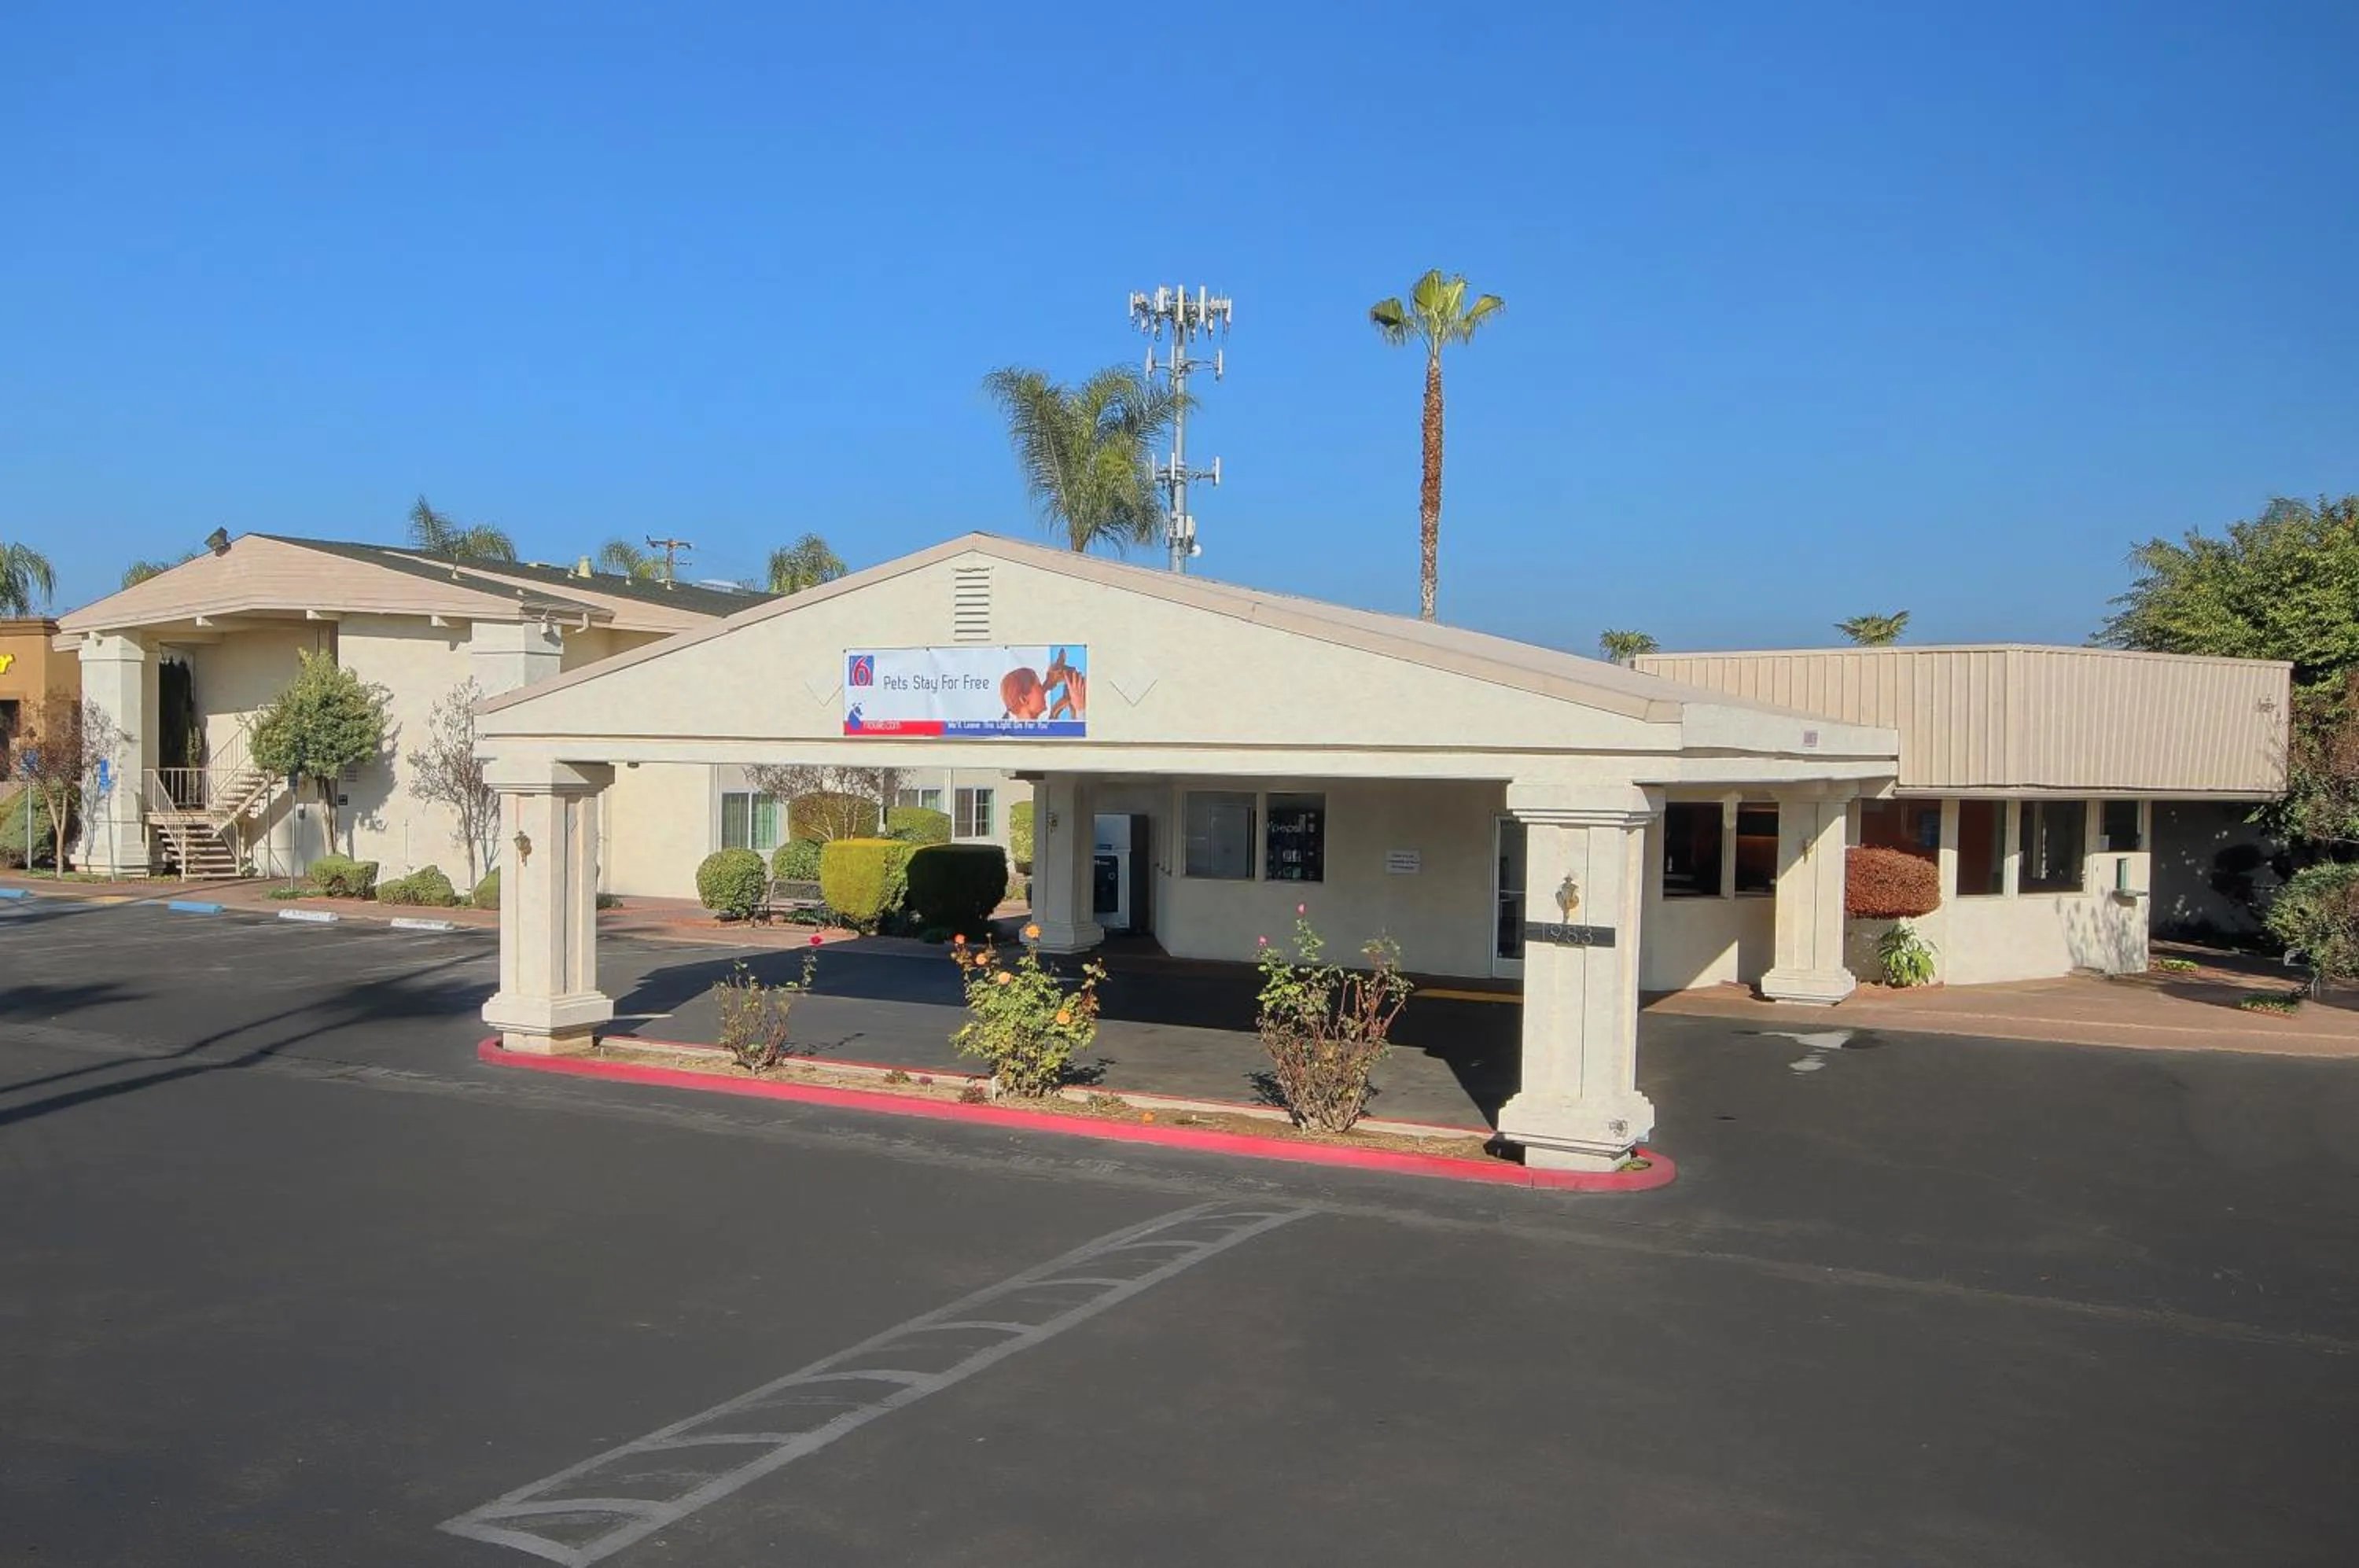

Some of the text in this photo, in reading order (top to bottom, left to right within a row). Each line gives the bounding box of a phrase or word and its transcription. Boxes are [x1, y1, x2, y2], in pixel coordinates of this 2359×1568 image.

[852, 655, 872, 687] 6
[883, 675, 990, 694] Pets Stay For Free
[1542, 922, 1594, 945] 1983
